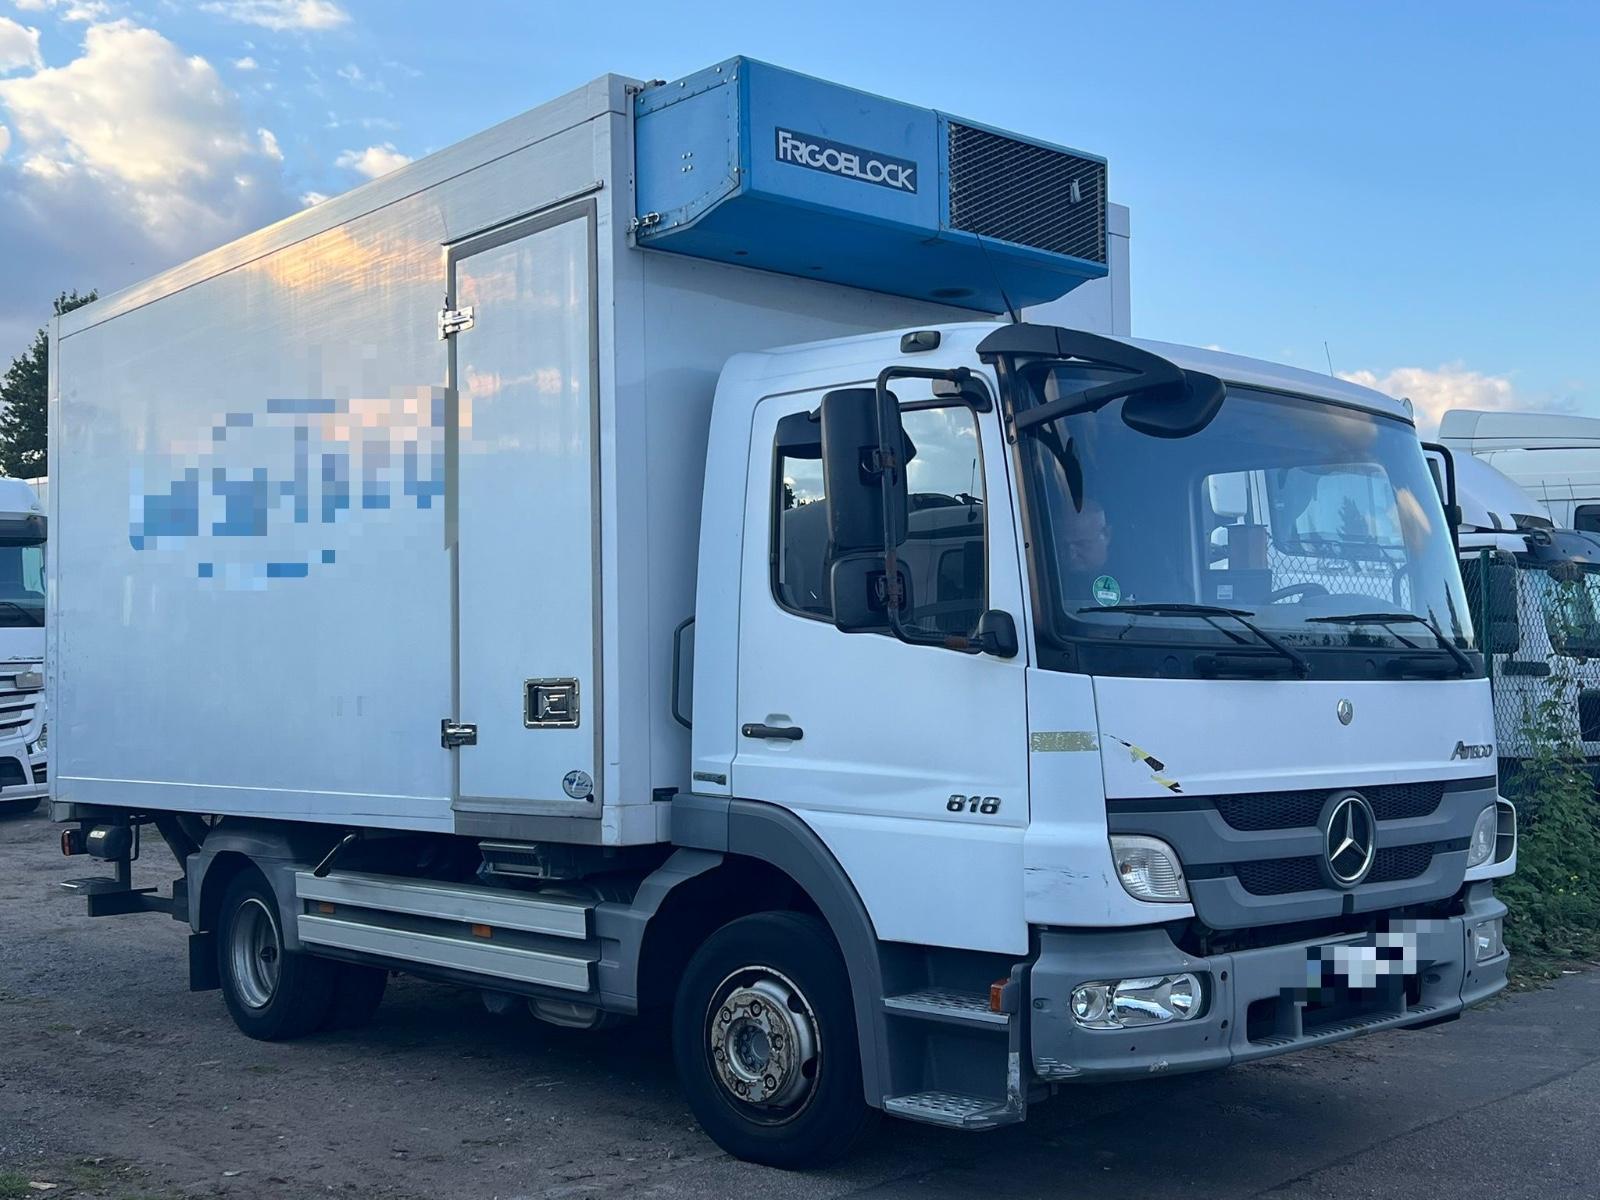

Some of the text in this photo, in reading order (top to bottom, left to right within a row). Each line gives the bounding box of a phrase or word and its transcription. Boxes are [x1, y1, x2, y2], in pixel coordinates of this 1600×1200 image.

[778, 130, 916, 191] FRIGOBLOCK
[1103, 577, 1111, 591] 4
[946, 795, 1001, 814] 818
